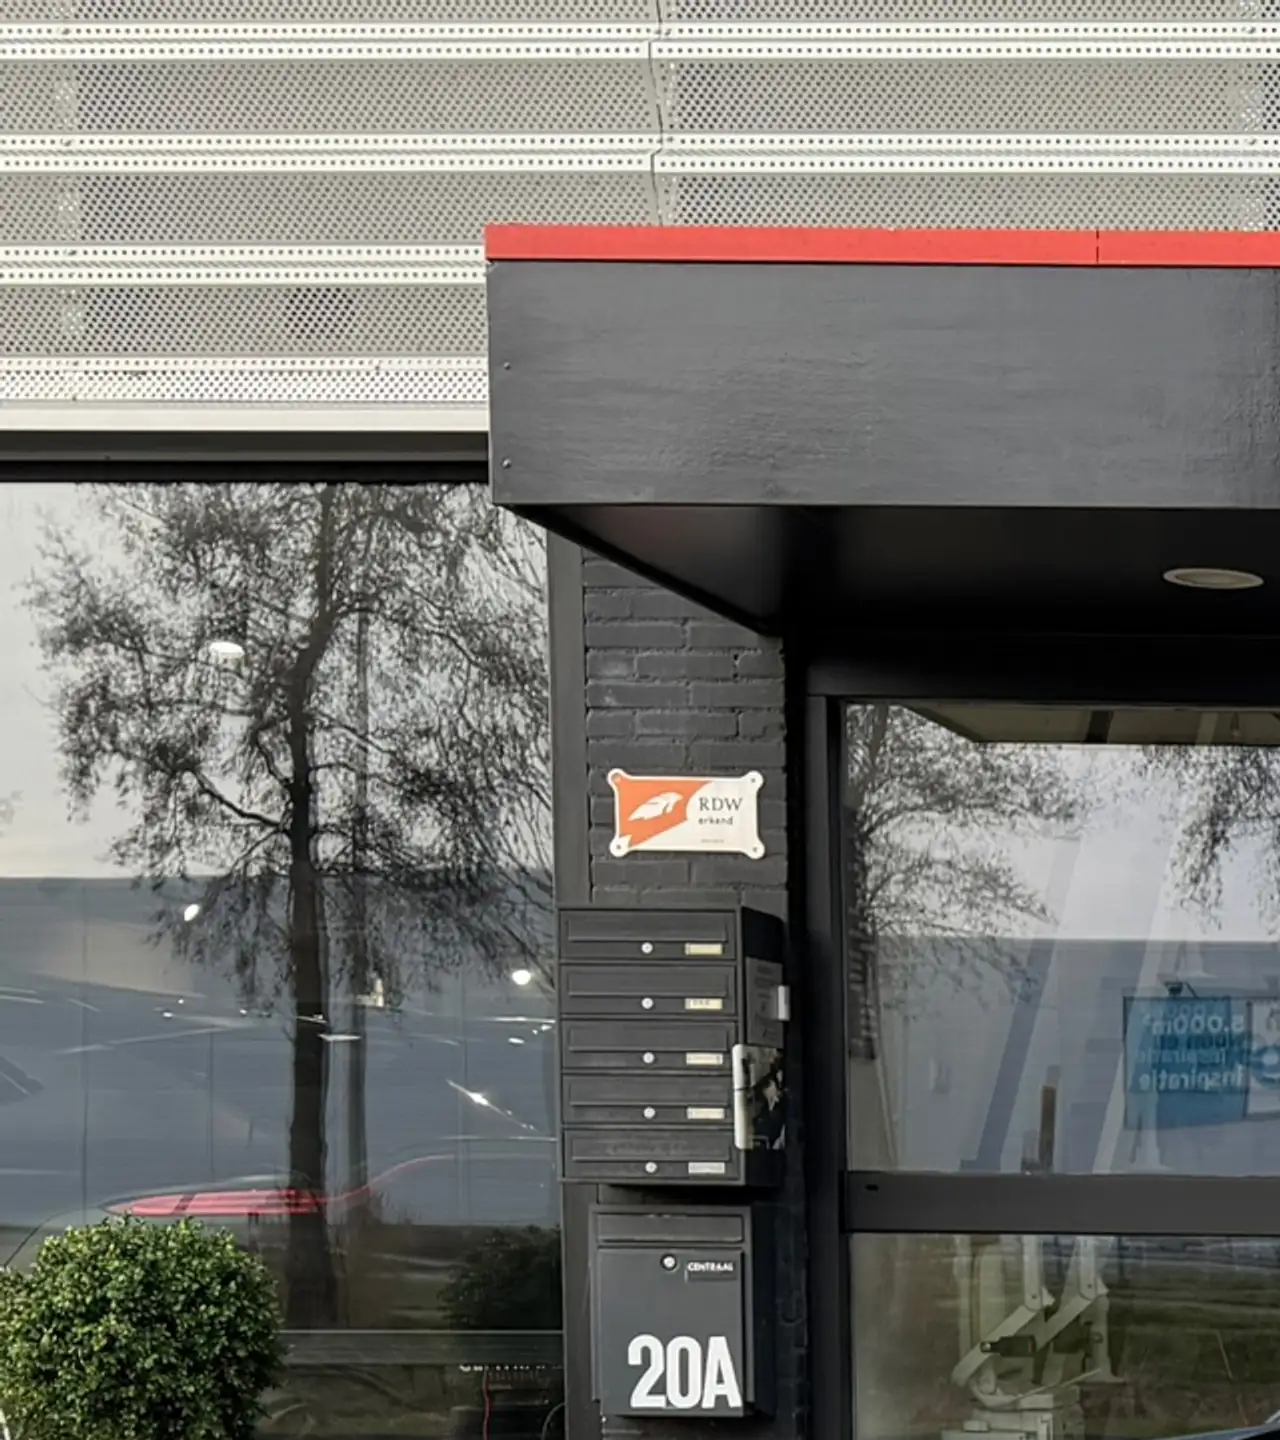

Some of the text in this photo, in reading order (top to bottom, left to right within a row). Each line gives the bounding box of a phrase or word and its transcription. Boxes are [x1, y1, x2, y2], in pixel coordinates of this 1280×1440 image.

[698, 796, 743, 812] RDW
[687, 1261, 734, 1272] CENTRAAL
[627, 1333, 743, 1410] 20A
